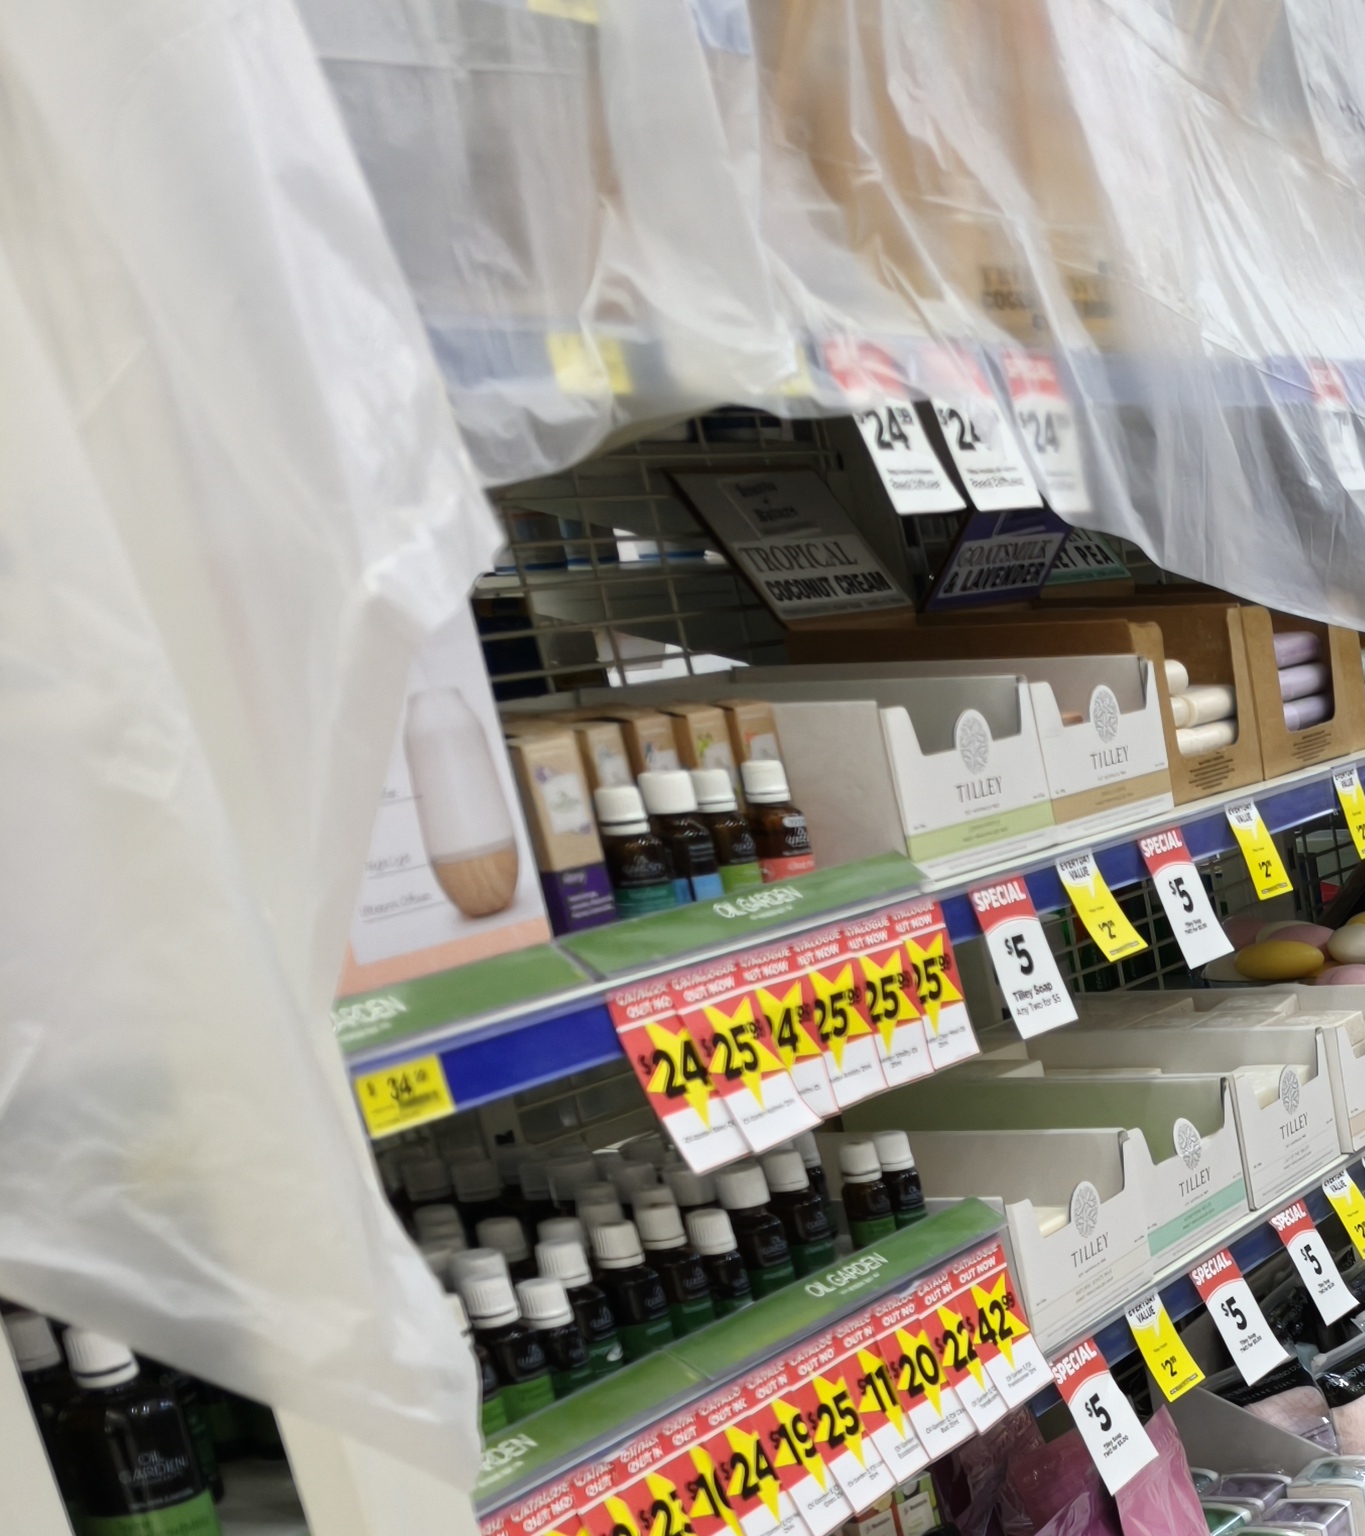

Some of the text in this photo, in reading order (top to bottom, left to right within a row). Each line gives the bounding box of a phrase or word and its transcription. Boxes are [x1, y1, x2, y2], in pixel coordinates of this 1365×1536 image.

[740, 541, 859, 574] TROPICAL
[764, 570, 893, 602] COCONUT CREAM
[943, 562, 1045, 594] & LAVENDER
[1090, 746, 1130, 770] TILLEY
[954, 774, 1004, 804] TILLEY
[1236, 811, 1252, 824] VALUE
[1141, 831, 1183, 858] SPECIAL
[1069, 867, 1090, 880] VALUE
[973, 881, 1026, 912] SPECIAL
[1169, 878, 1194, 913] $5
[1004, 934, 1034, 976] $5
[1012, 983, 1054, 1000] Tilley Soap
[1279, 1112, 1308, 1140] TILLEY
[1178, 1167, 1211, 1197] TILLEY
[1331, 1180, 1347, 1193] VALUE
[1272, 1203, 1306, 1231] SPECIAL
[1071, 1233, 1109, 1268] TILLEY
[1301, 1244, 1323, 1275] $5
[826, 1252, 889, 1288] GARDEN
[959, 1256, 997, 1284] OUT NOW
[1191, 1249, 1232, 1285] SPECIAL
[1136, 1306, 1156, 1324] VALUE
[1221, 1296, 1248, 1330] $5
[890, 1344, 939, 1398] $20
[1052, 1342, 1097, 1384] SPECIAL
[808, 1390, 859, 1448] $25
[1085, 1393, 1112, 1432] $5
